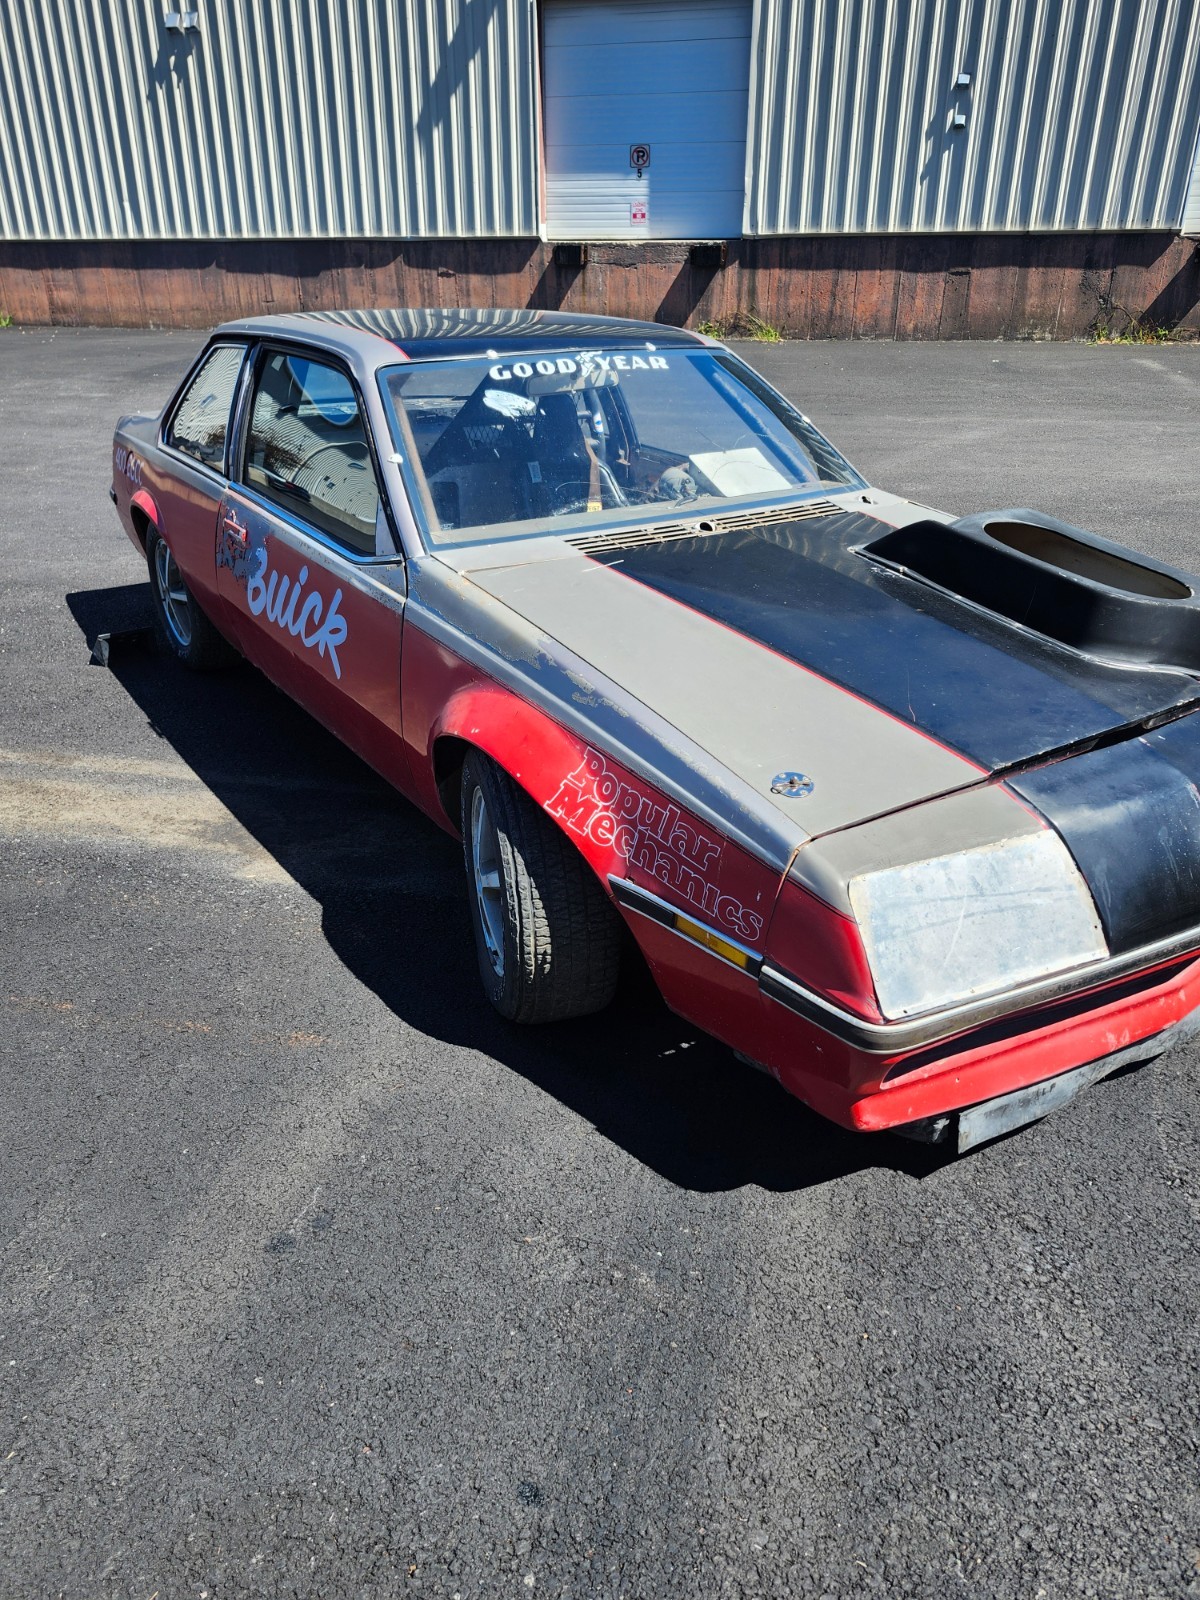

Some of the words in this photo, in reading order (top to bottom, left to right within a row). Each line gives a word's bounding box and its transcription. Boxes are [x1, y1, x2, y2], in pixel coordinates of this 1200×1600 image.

[637, 169, 642, 178] 5
[247, 546, 348, 680] Buick
[544, 779, 764, 941] Mechanics
[567, 746, 721, 871] Popular
